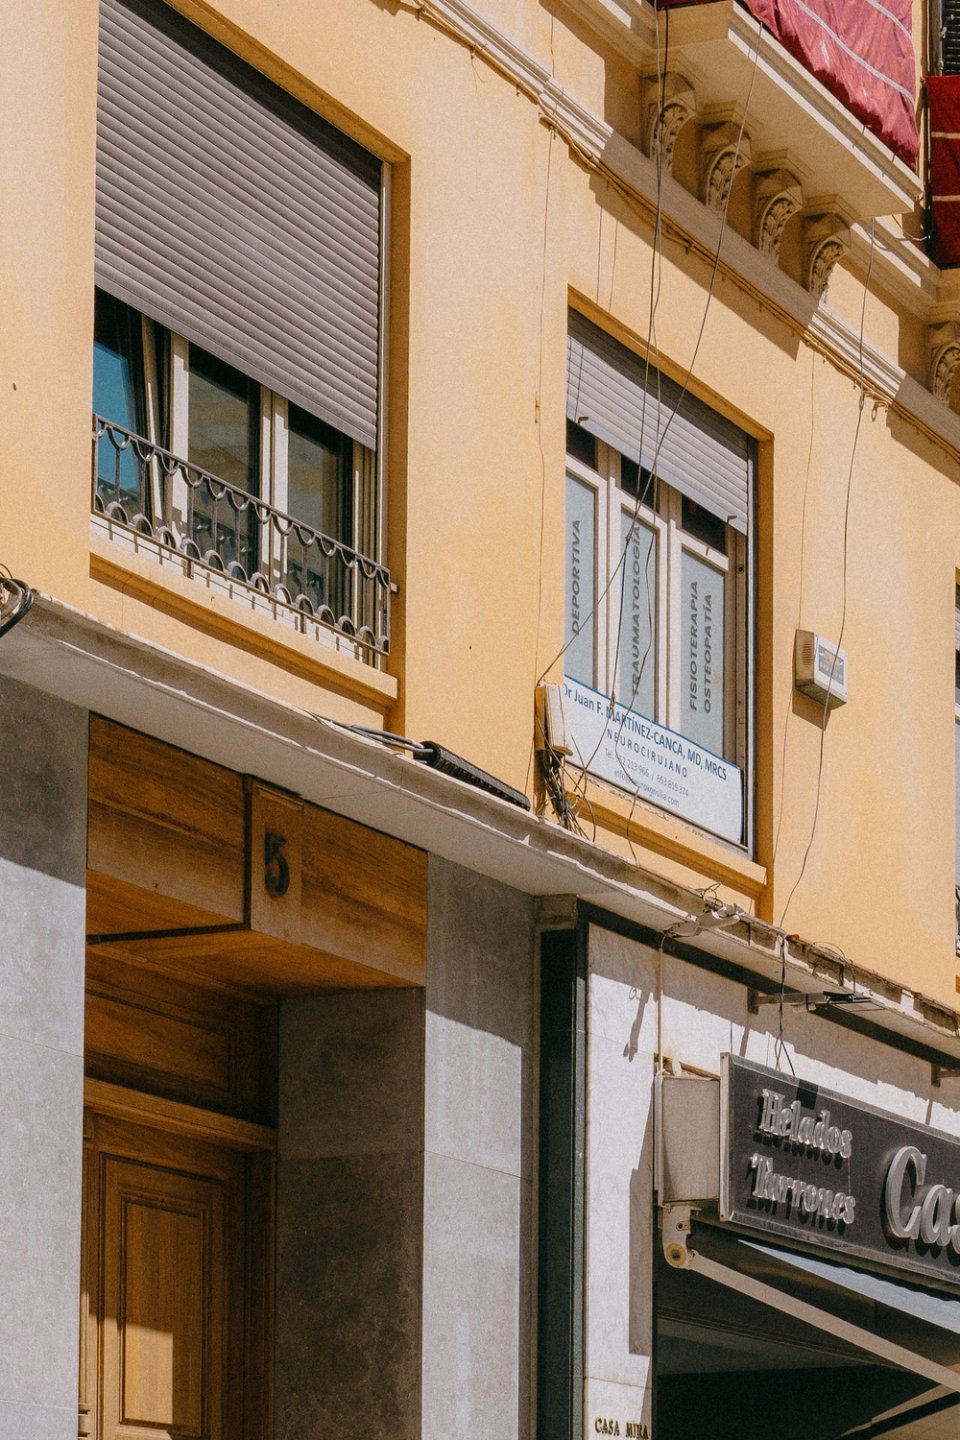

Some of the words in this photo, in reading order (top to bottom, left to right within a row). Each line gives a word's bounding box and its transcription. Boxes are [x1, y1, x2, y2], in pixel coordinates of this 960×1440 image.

[571, 519, 581, 636] DEPORTIVA
[632, 526, 641, 696] TRAUMATOLOGÍA
[689, 581, 698, 711] FISIOTERAPIA
[703, 594, 712, 714] OSTEOPATÍA
[574, 689, 595, 711] Juan
[596, 701, 604, 716] F.
[687, 748, 703, 770] MD,
[704, 760, 728, 780] MRCS
[606, 728, 689, 779] NEUROCIRUJANO
[759, 1088, 853, 1159] Helados
[750, 1153, 856, 1225] Turrones
[594, 1417, 620, 1437] CASA
[625, 1422, 649, 1440] MIRA
